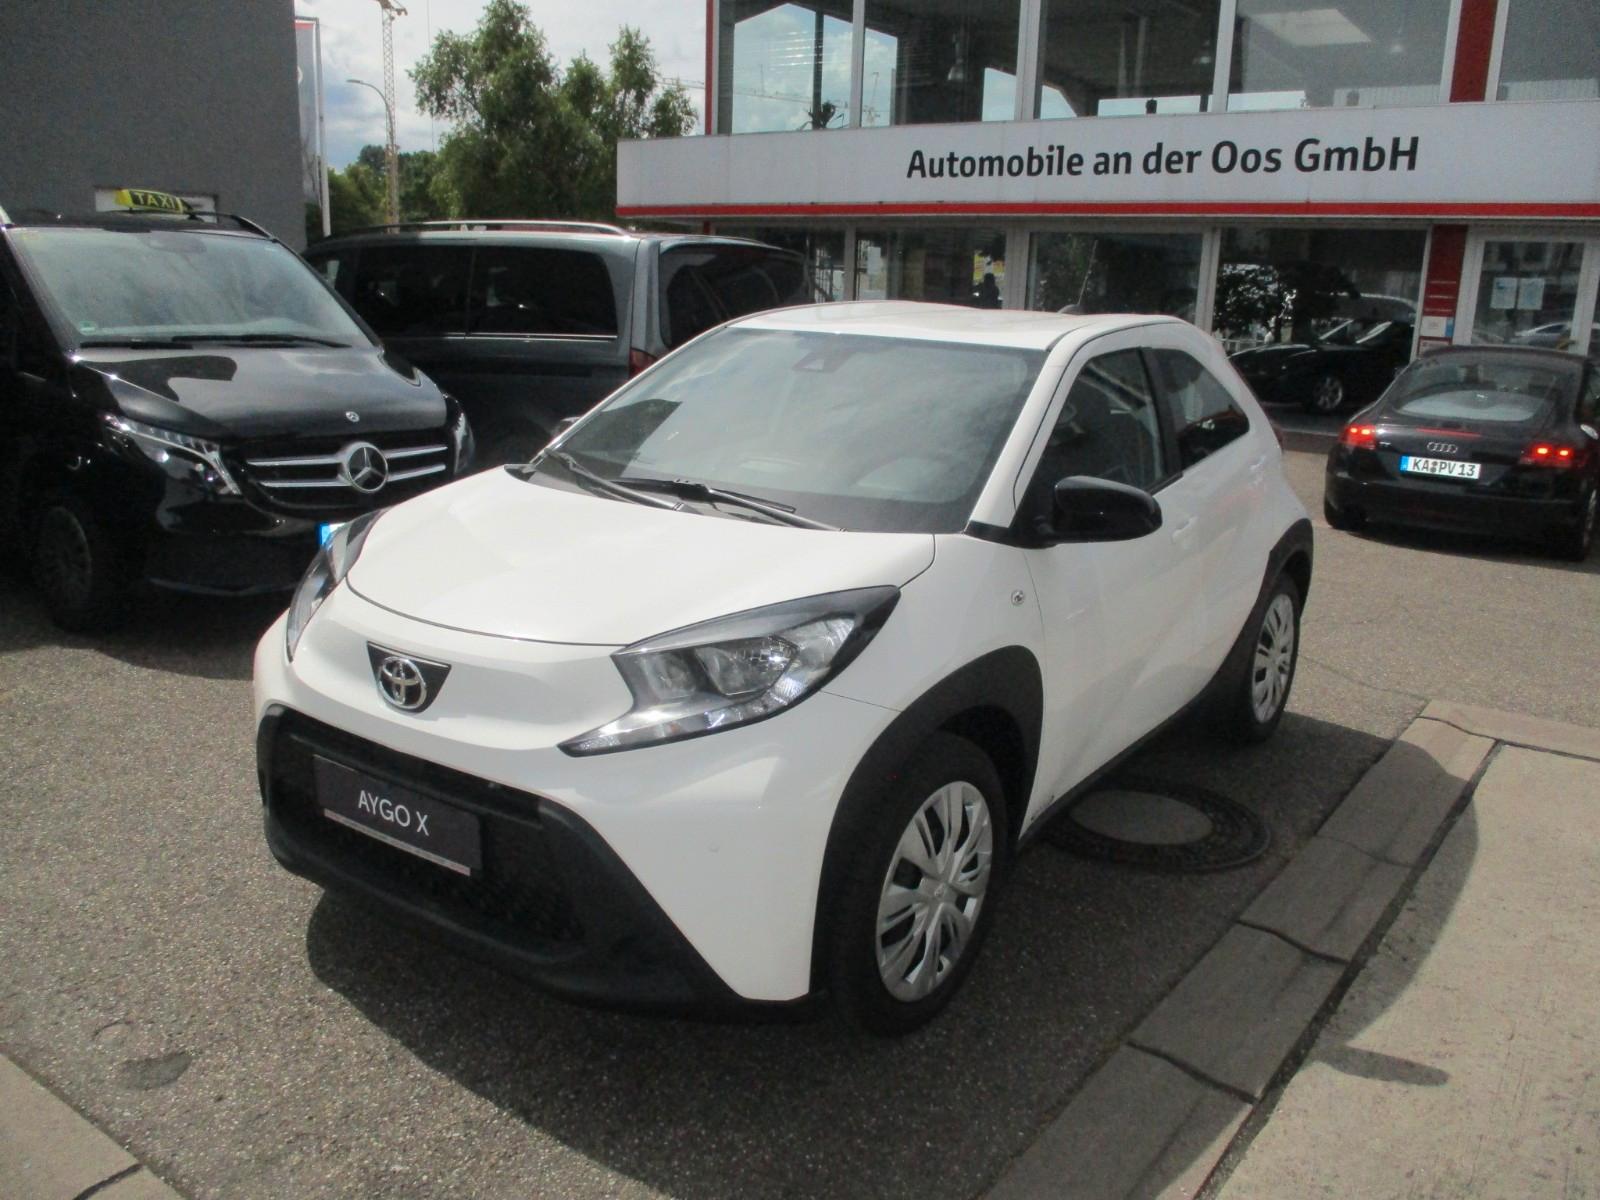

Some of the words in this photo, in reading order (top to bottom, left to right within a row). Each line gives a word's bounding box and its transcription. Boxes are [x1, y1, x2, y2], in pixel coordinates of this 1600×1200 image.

[906, 144, 1084, 179] Automobile
[1093, 150, 1132, 176] an
[1142, 142, 1202, 175] der
[1211, 140, 1283, 174] Oos
[1295, 136, 1419, 173] GmbH
[133, 191, 176, 209] TAXI
[358, 789, 411, 828] AYGO
[416, 811, 429, 837] X
